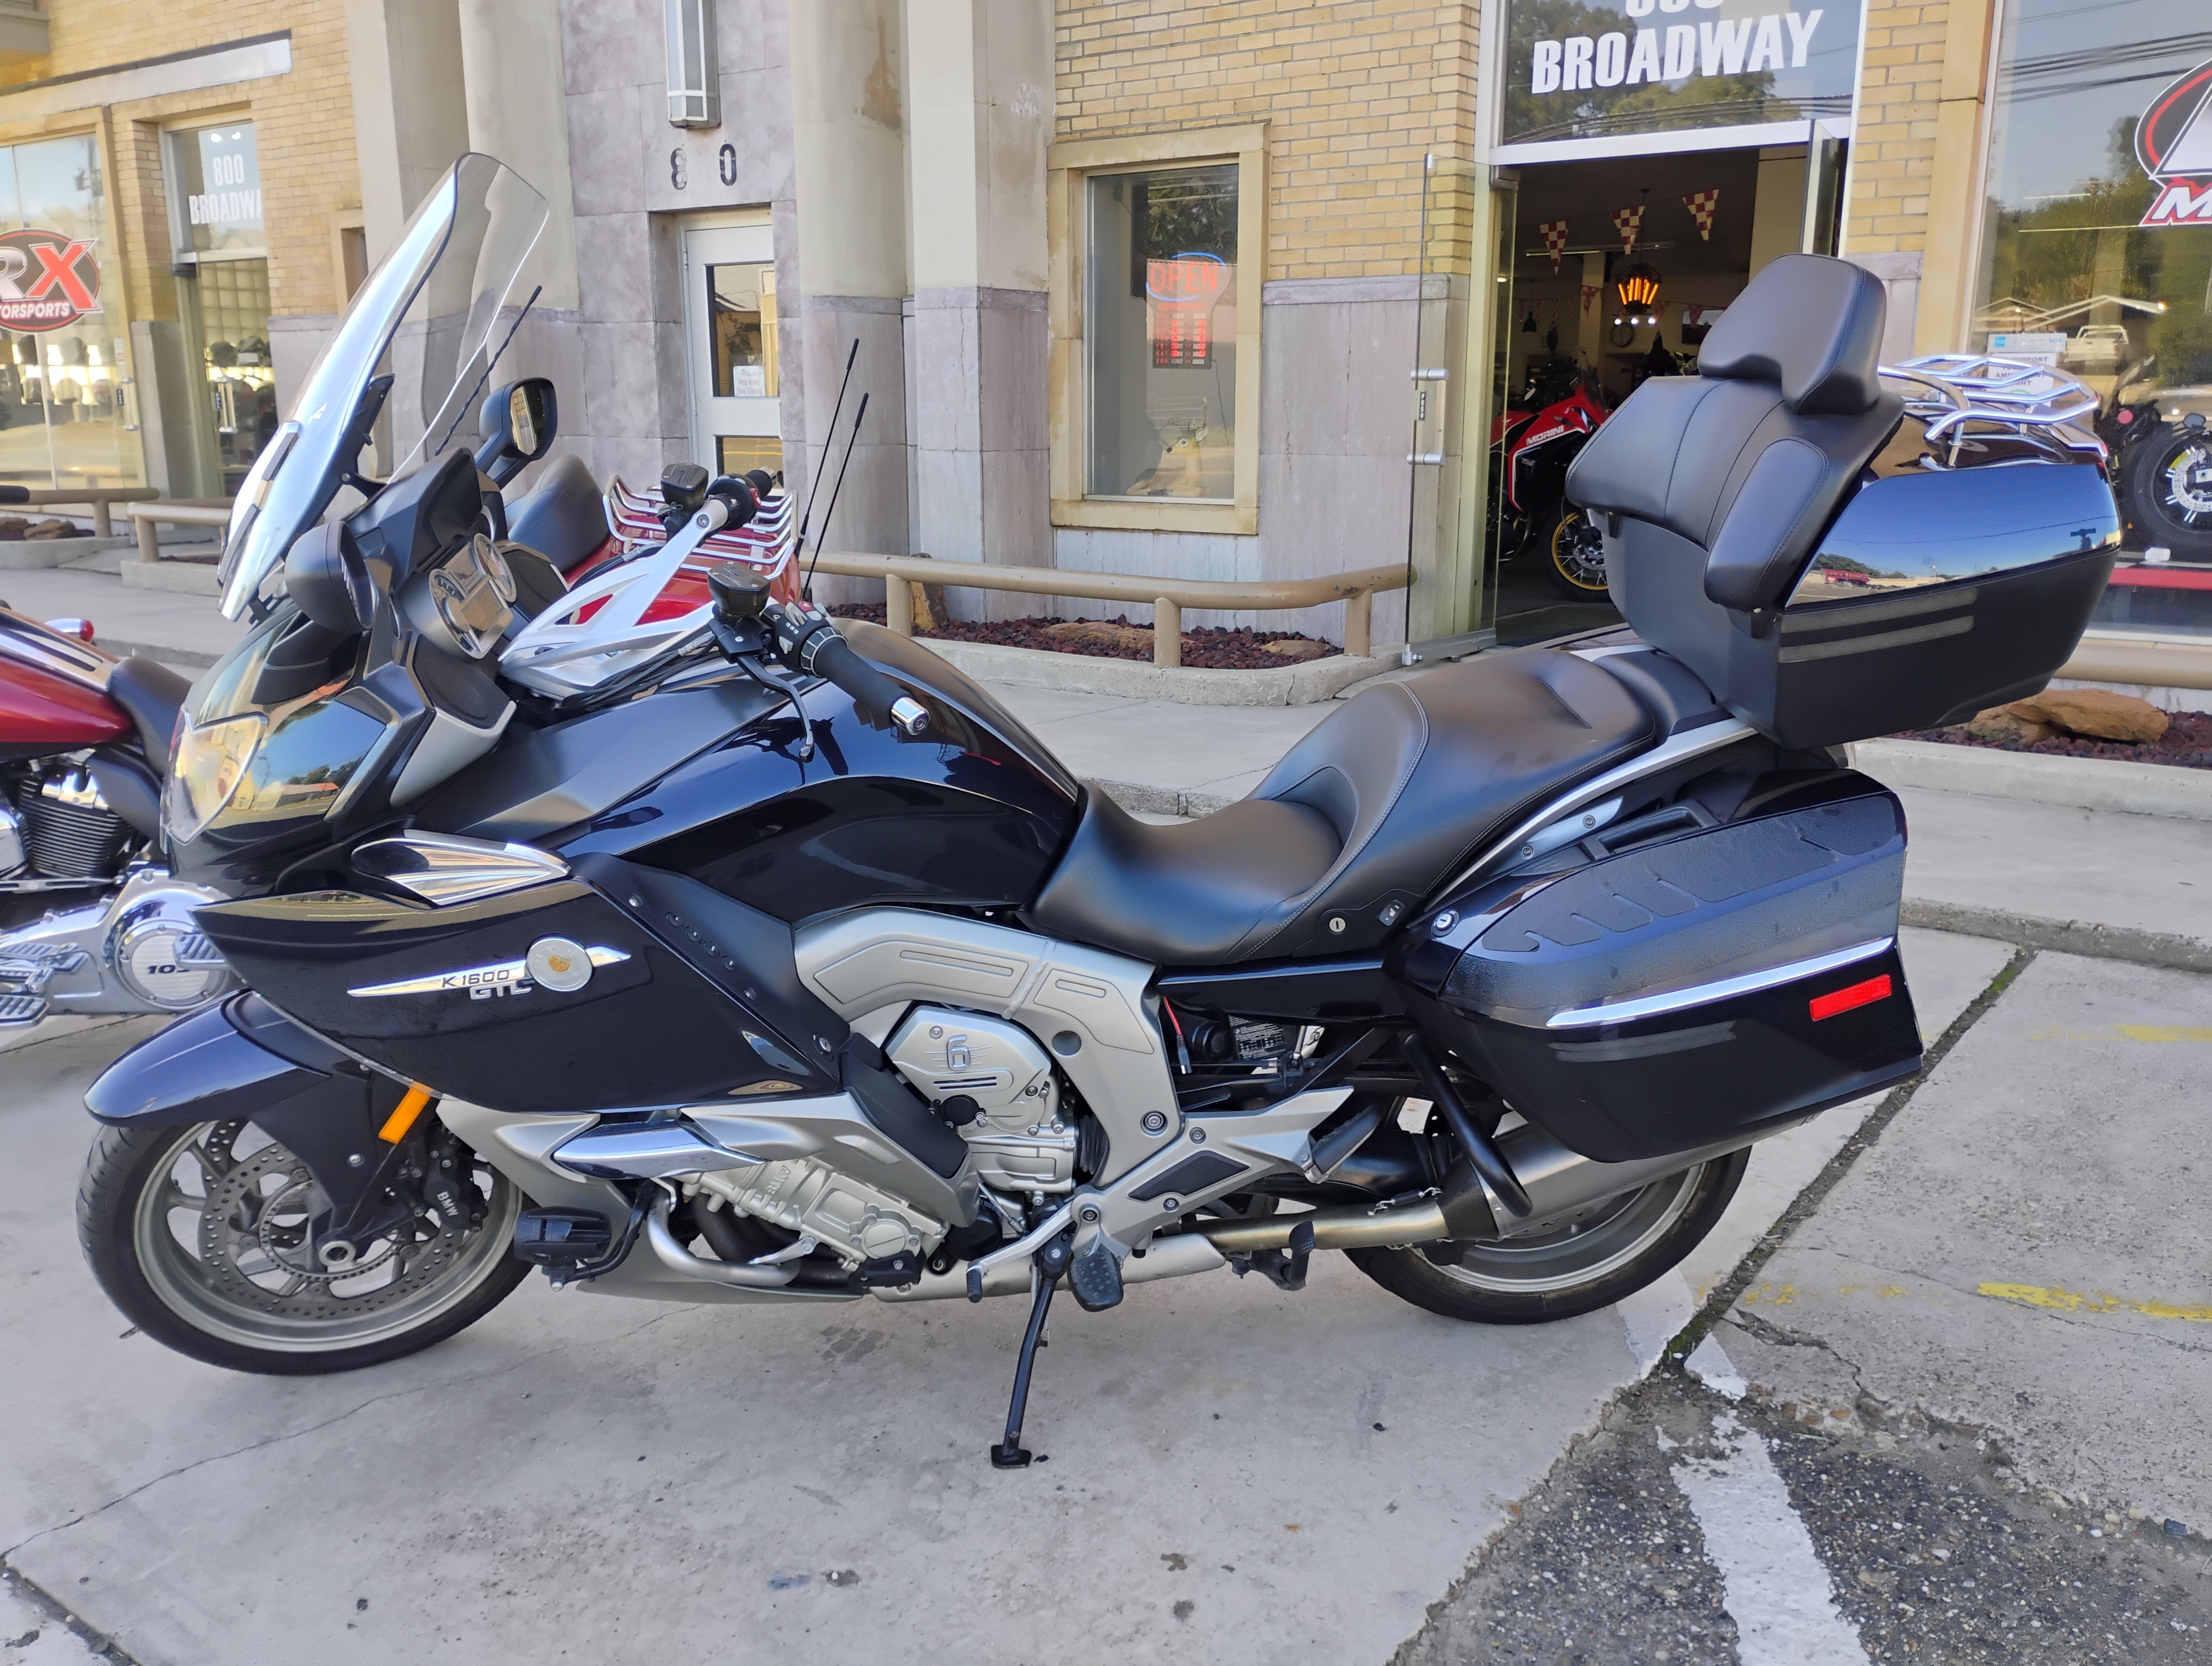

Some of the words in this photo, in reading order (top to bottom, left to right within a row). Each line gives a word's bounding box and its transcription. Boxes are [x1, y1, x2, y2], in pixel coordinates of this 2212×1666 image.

[1532, 9, 1823, 94] BROADWAY
[213, 154, 245, 186] 800
[719, 144, 737, 186] 0
[1150, 261, 1218, 292] OPEN
[0, 302, 70, 319] ORSPORTS
[1527, 425, 1564, 445] MORINI
[946, 1034, 971, 1072] 6
[766, 1164, 792, 1195] BMW
[436, 1191, 460, 1216] BMW
